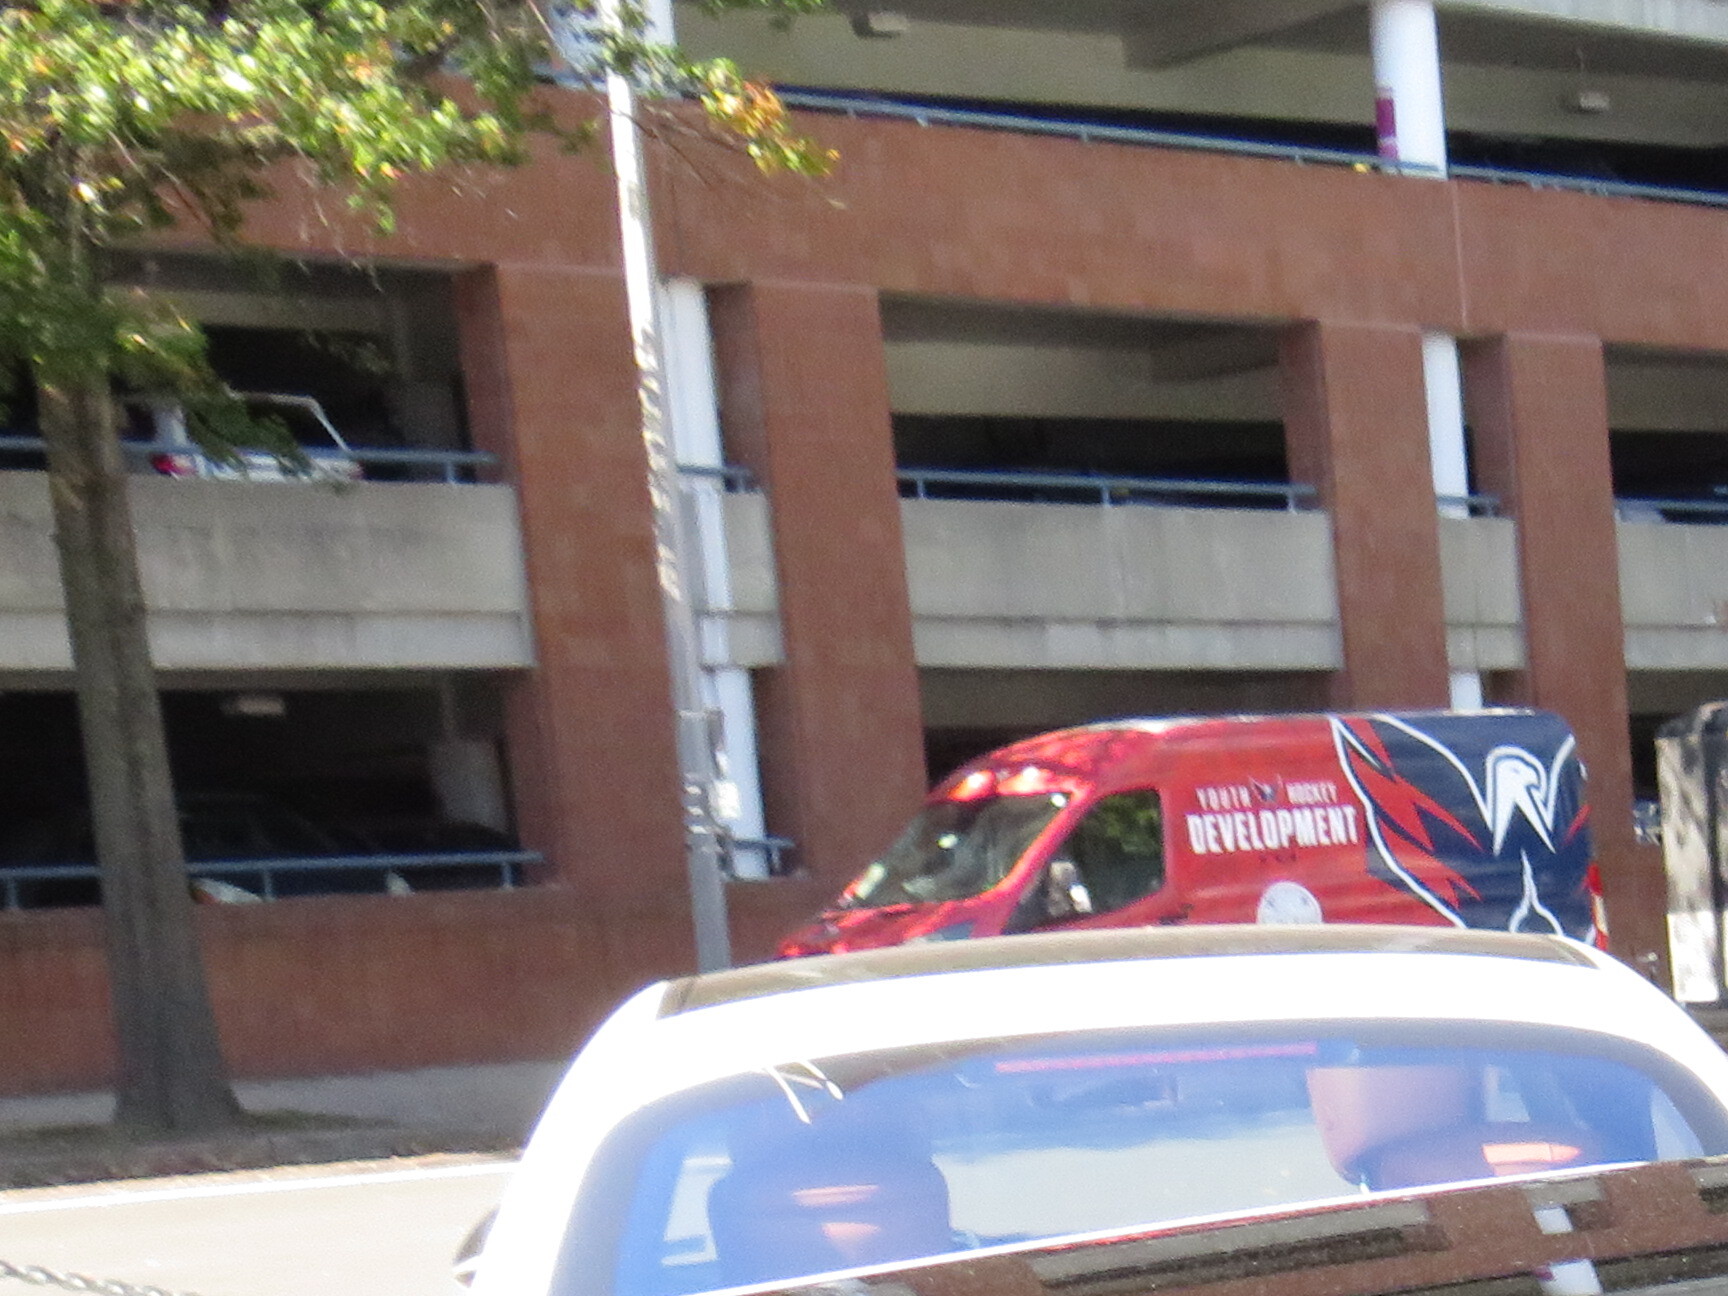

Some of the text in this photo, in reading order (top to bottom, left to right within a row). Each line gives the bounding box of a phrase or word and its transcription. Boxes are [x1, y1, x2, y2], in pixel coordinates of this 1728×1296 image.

[1196, 781, 1338, 811] YOUTH HOCKEY
[1186, 804, 1359, 855] DEVELOPMENT
